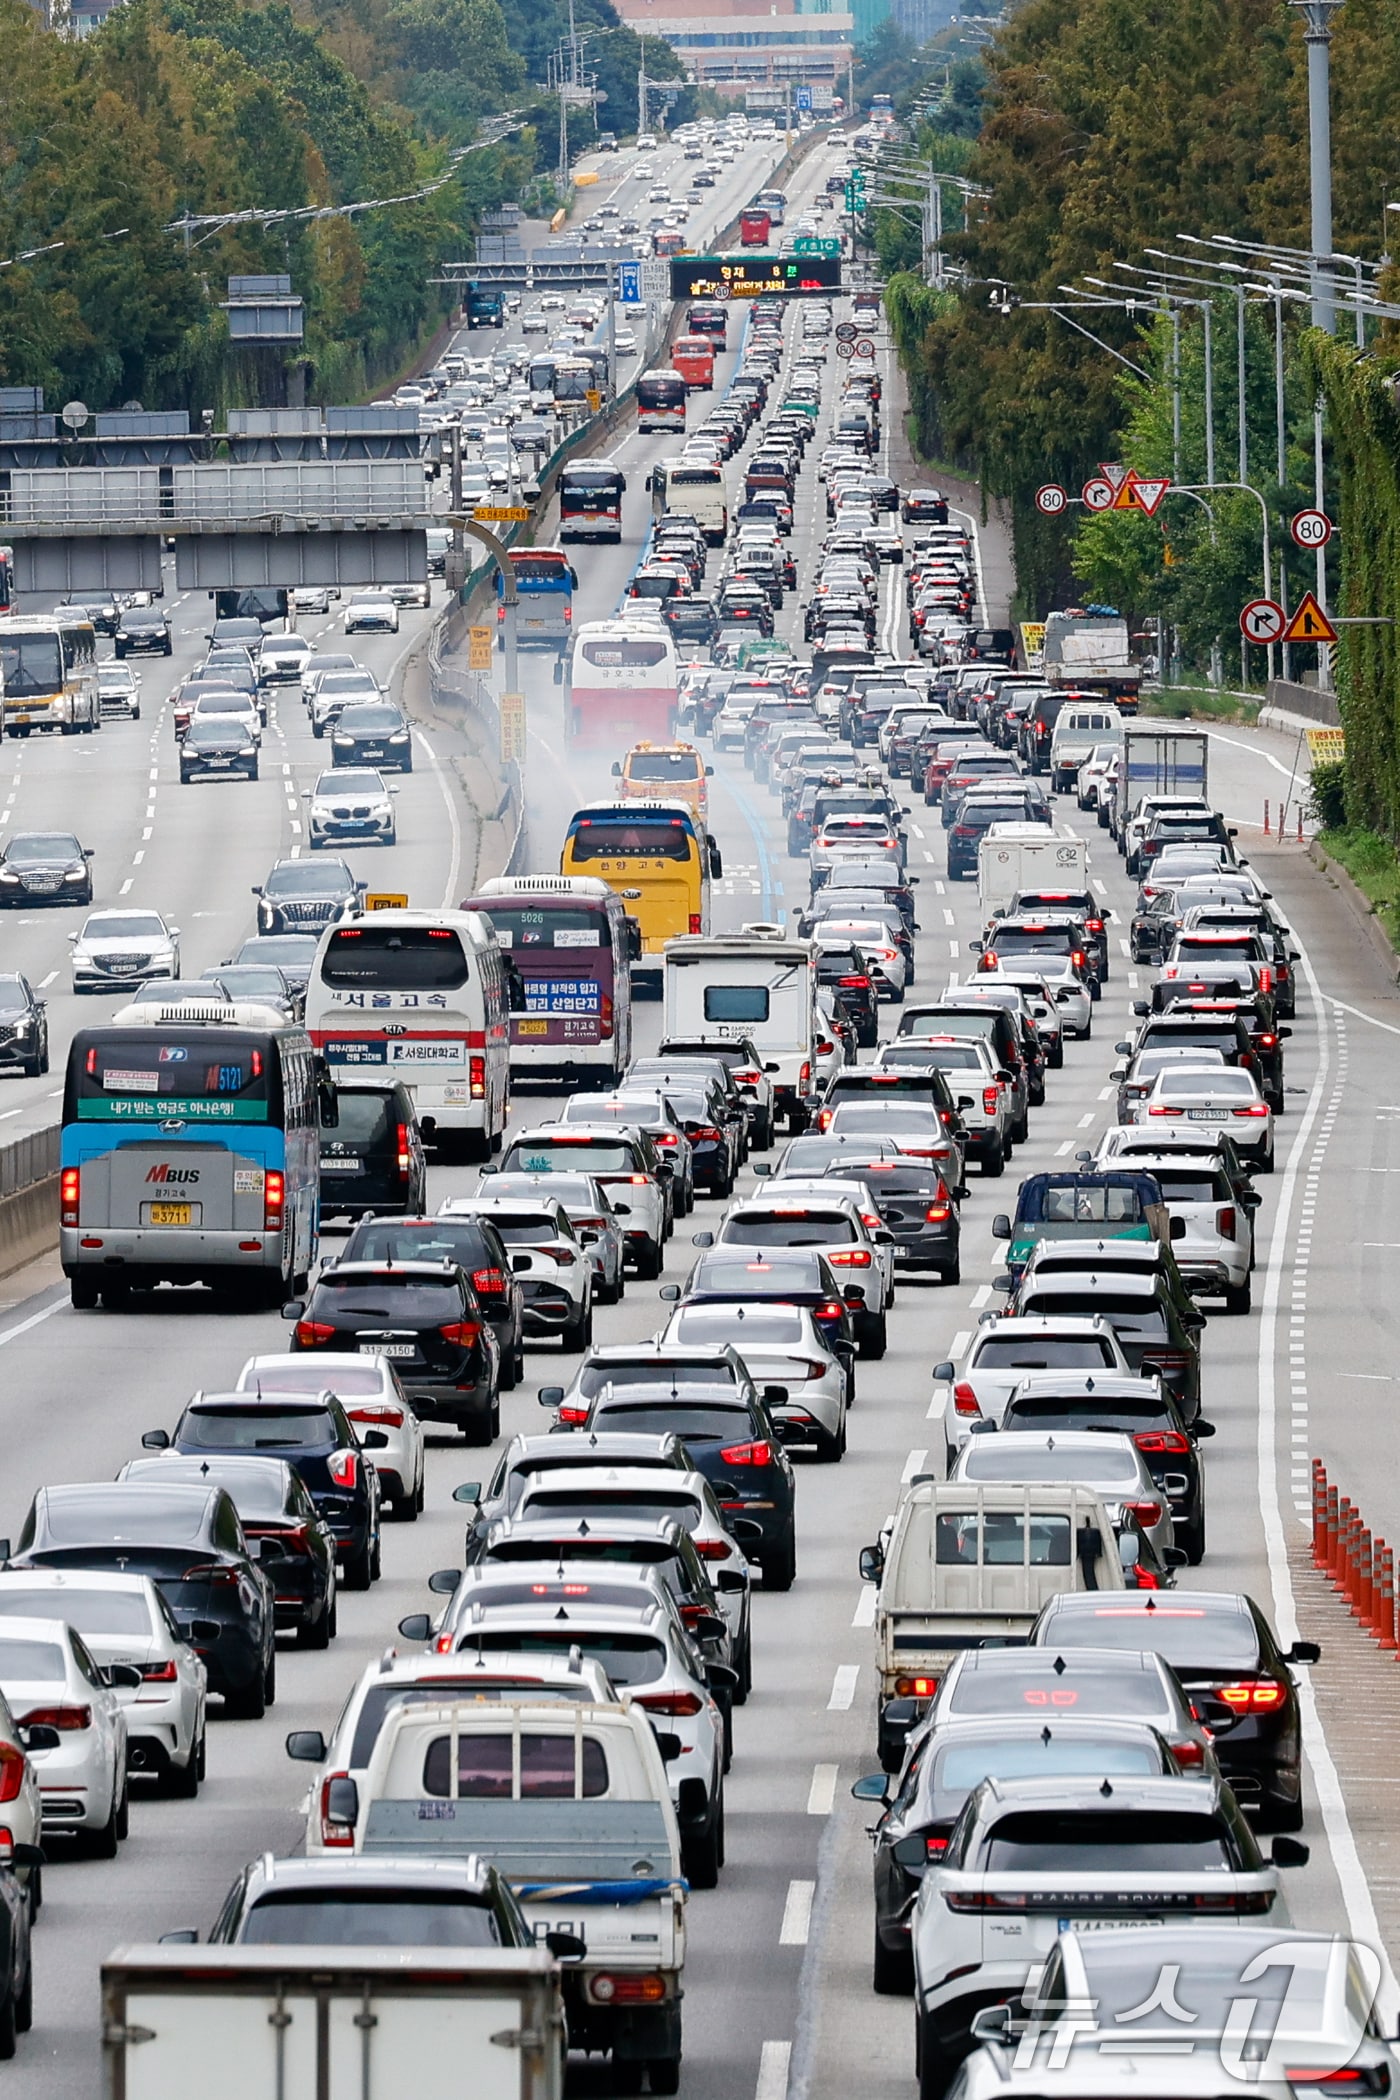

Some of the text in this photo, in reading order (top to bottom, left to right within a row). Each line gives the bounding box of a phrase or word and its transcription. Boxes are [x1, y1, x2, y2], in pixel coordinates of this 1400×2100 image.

[1042, 493, 1061, 508] 80
[1300, 520, 1324, 539] 80
[343, 992, 448, 1009] 서울고속
[551, 997, 598, 1011] 산업단지
[384, 1024, 405, 1035] KIA
[404, 1047, 460, 1060] 서원대학교
[110, 1102, 235, 1116] 내가 받는 연금도 하나은행!
[144, 1162, 201, 1184] MBUS
[154, 1188, 187, 1199] 경기고속
[386, 1346, 411, 1355] 6150
